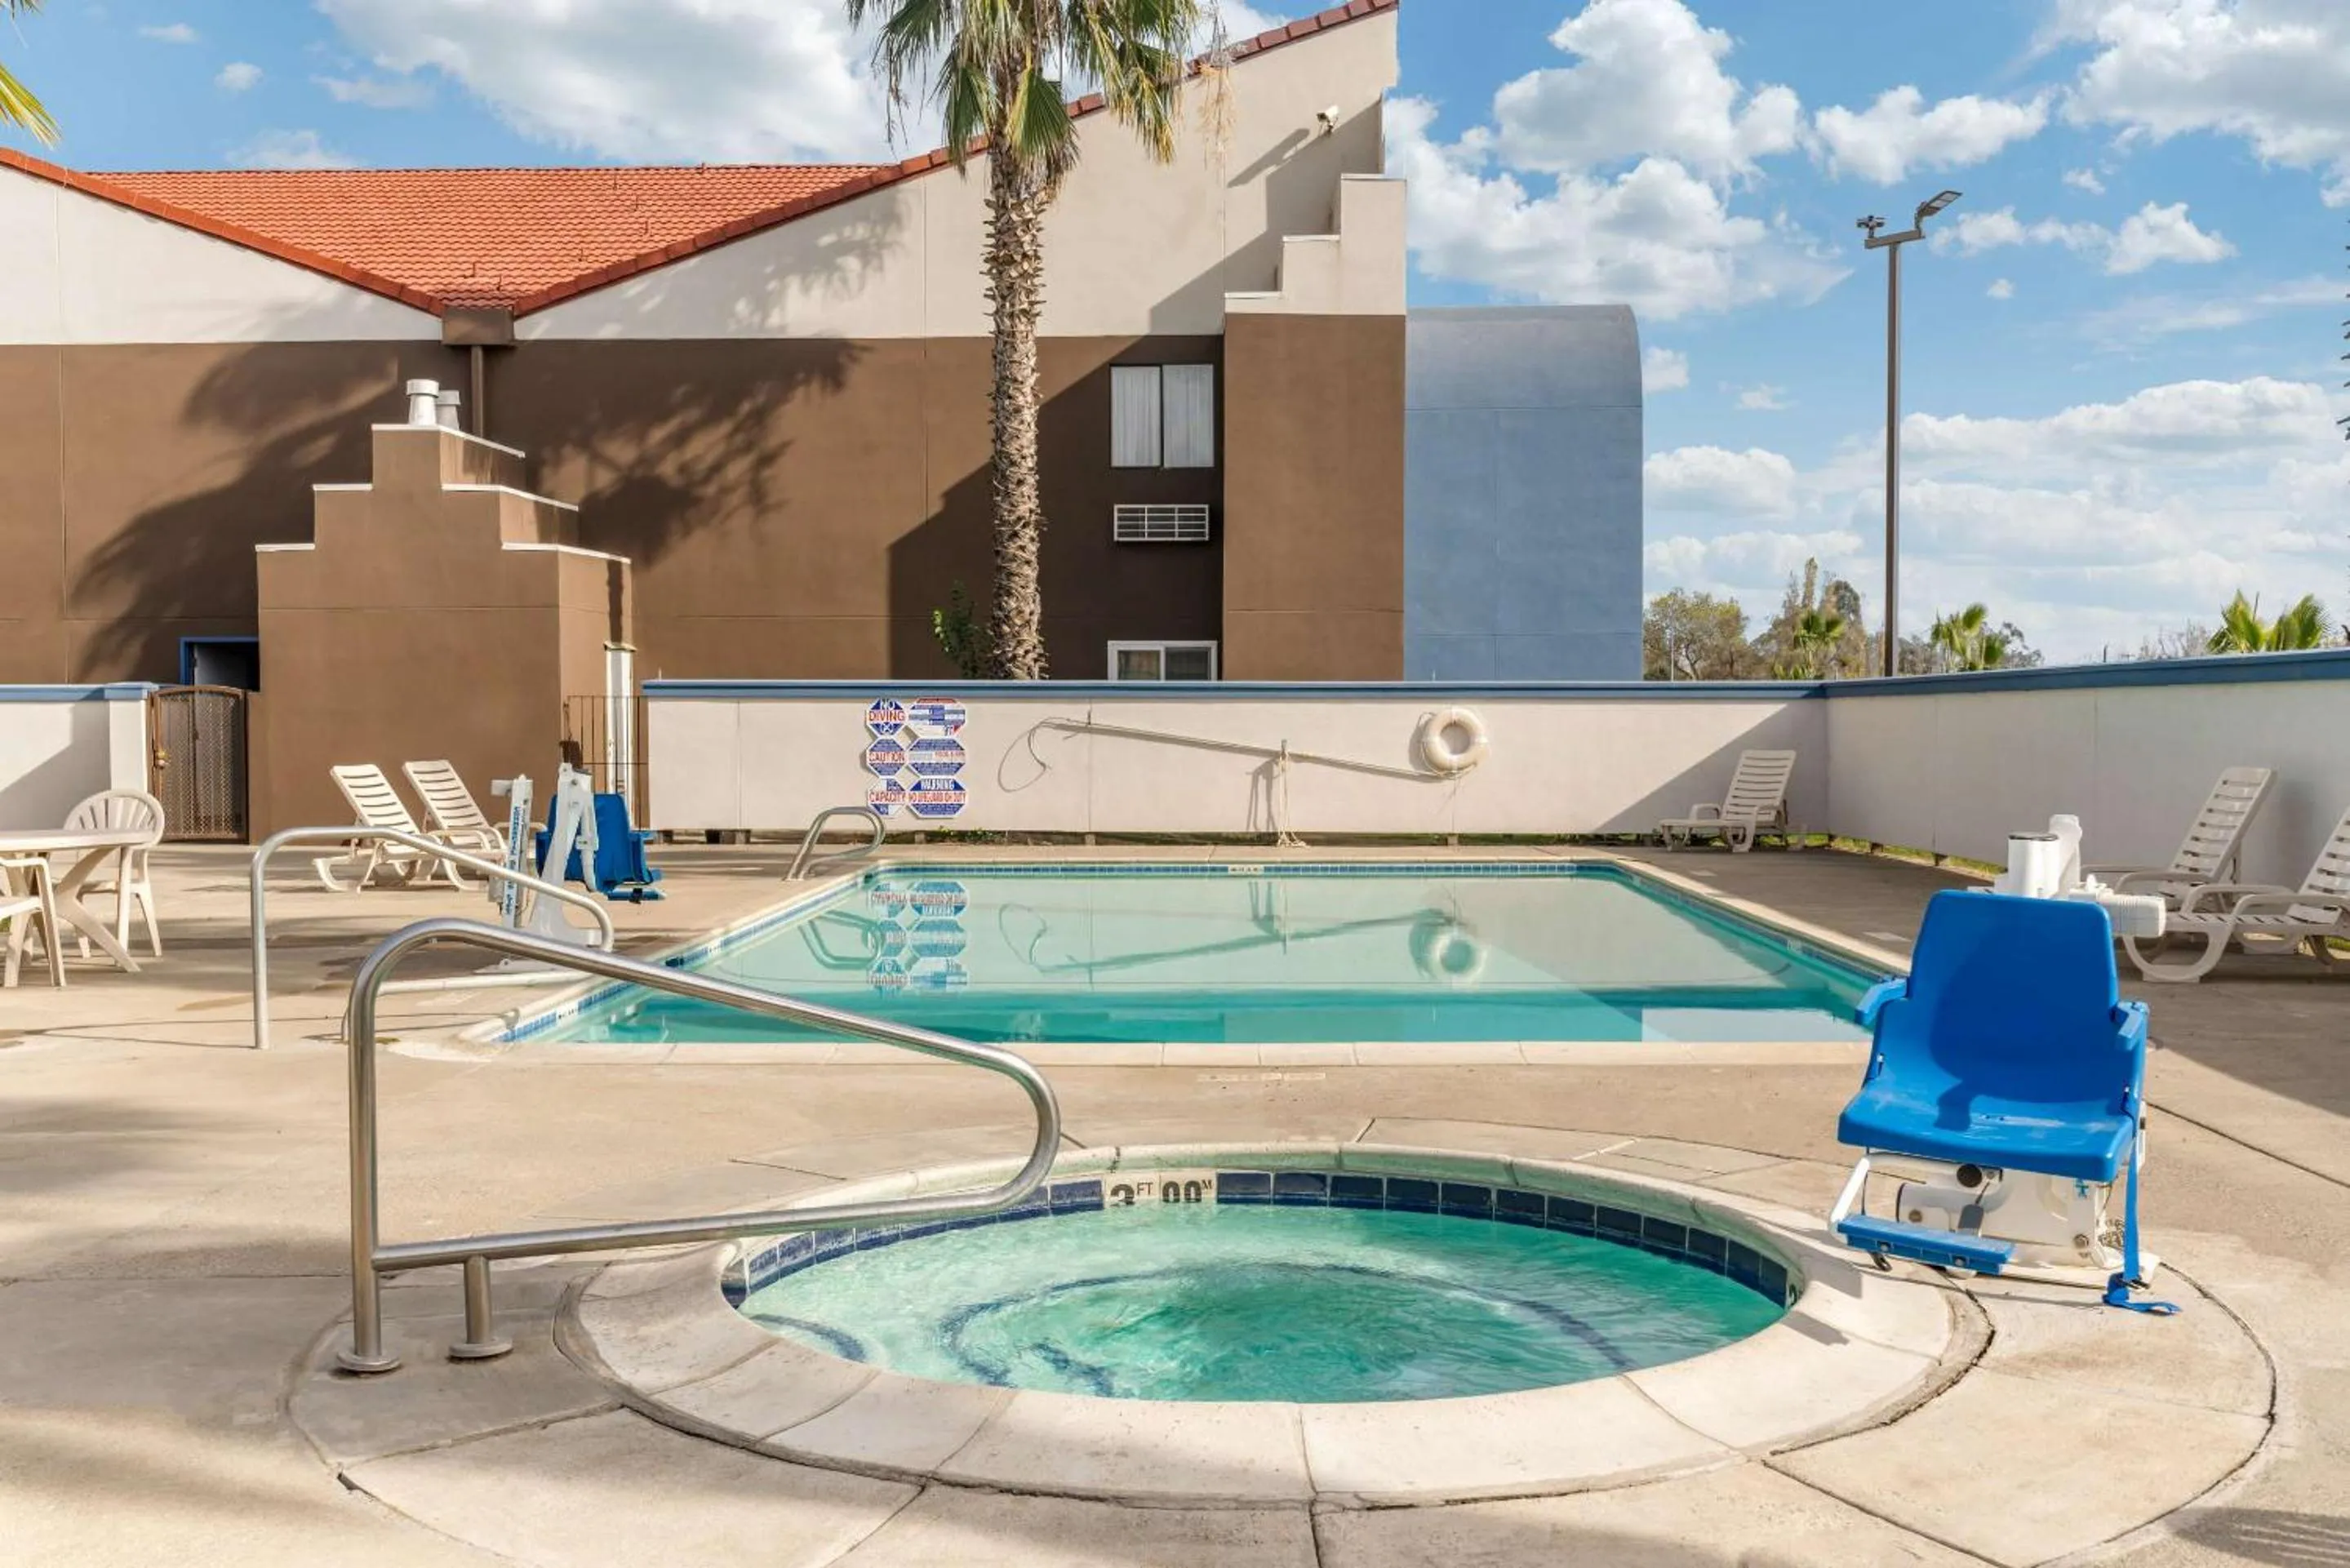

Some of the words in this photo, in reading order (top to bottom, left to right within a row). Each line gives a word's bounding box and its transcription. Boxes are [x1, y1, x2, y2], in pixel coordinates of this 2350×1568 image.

[869, 710, 905, 722] DIVING
[869, 752, 905, 762] CAUTION
[869, 792, 906, 802] CAPACITY
